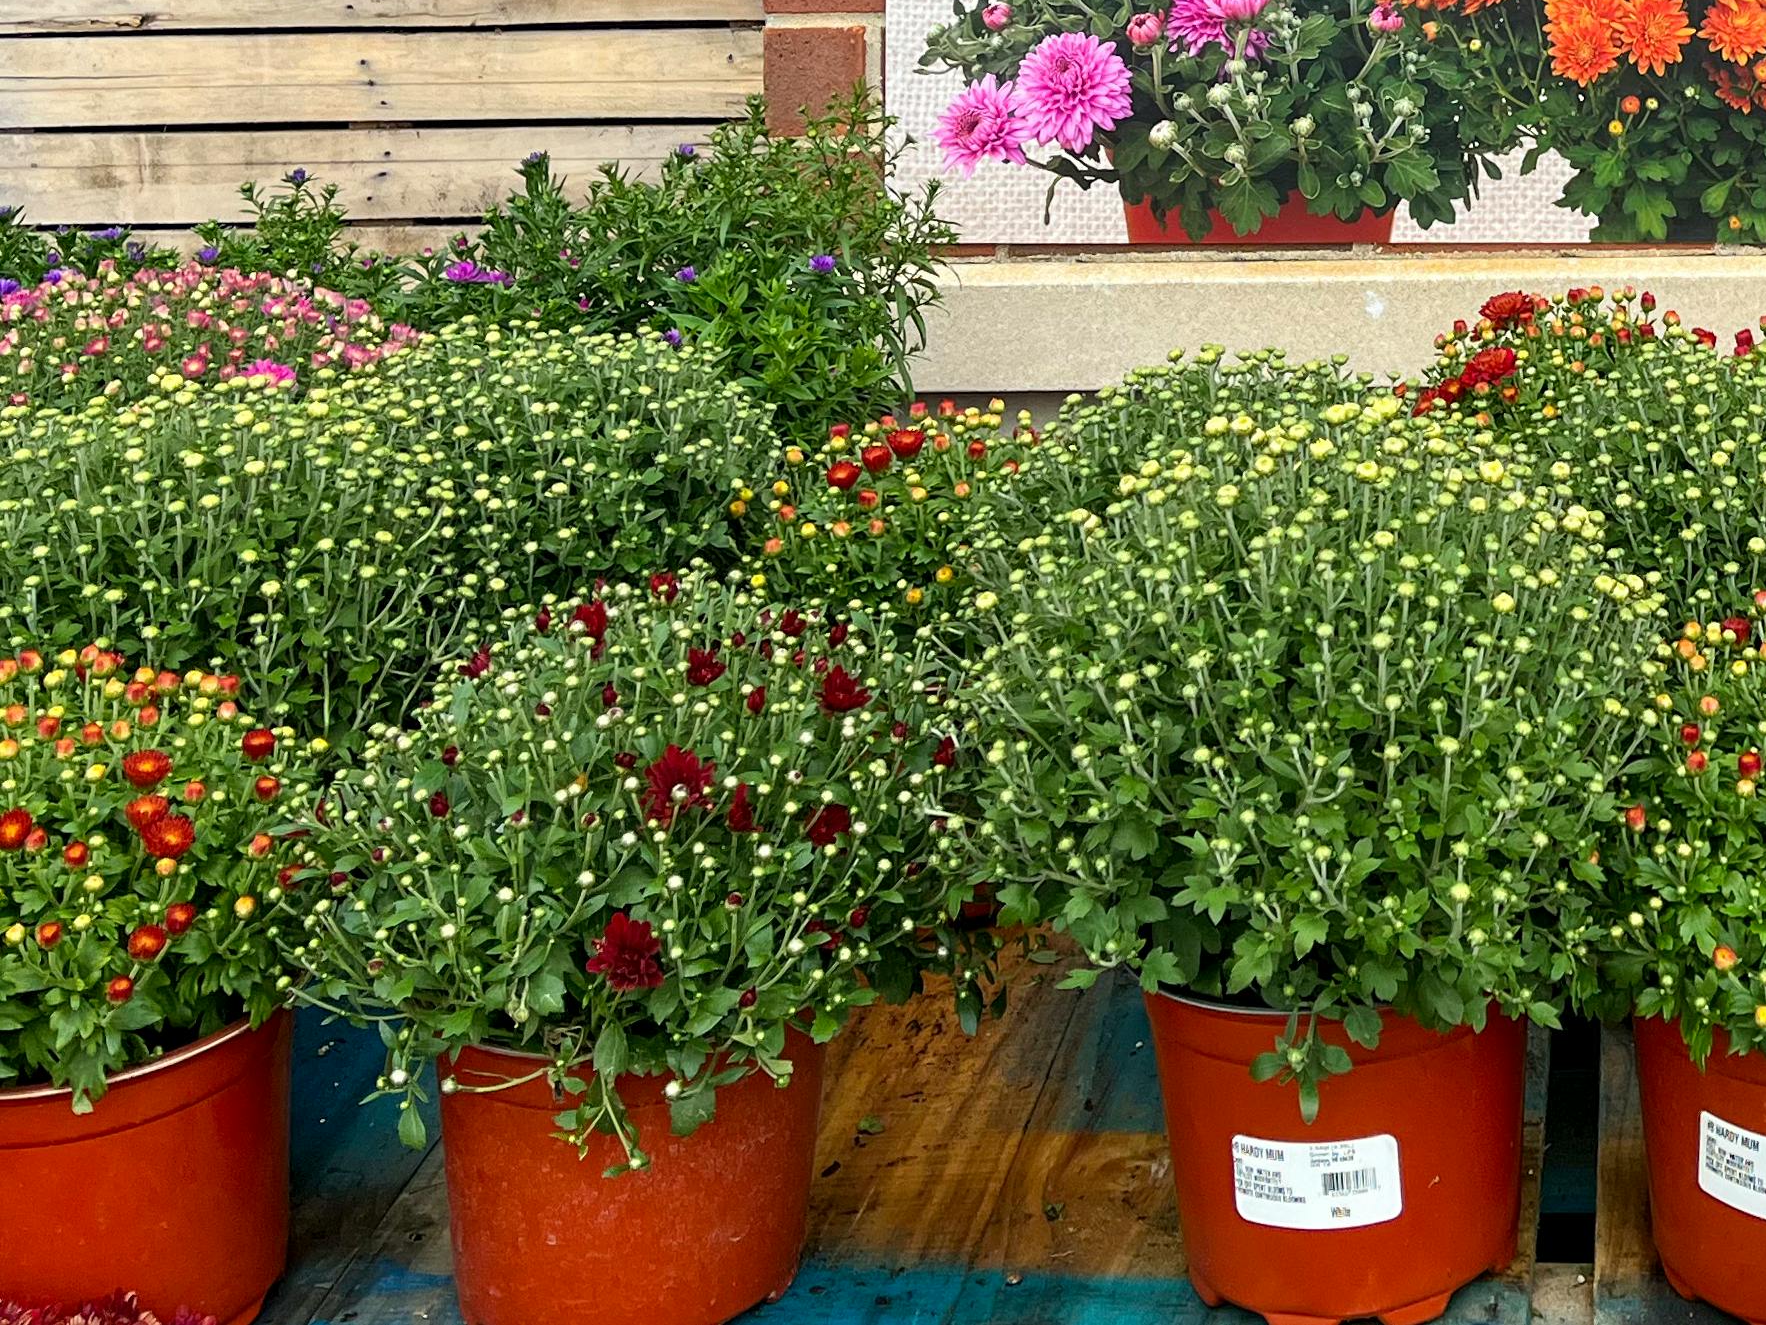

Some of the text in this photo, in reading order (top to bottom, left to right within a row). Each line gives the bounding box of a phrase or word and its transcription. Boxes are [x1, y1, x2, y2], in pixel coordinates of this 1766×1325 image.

[1716, 1126, 1760, 1152] HARDY MUM
[1266, 1148, 1285, 1162] MUM
